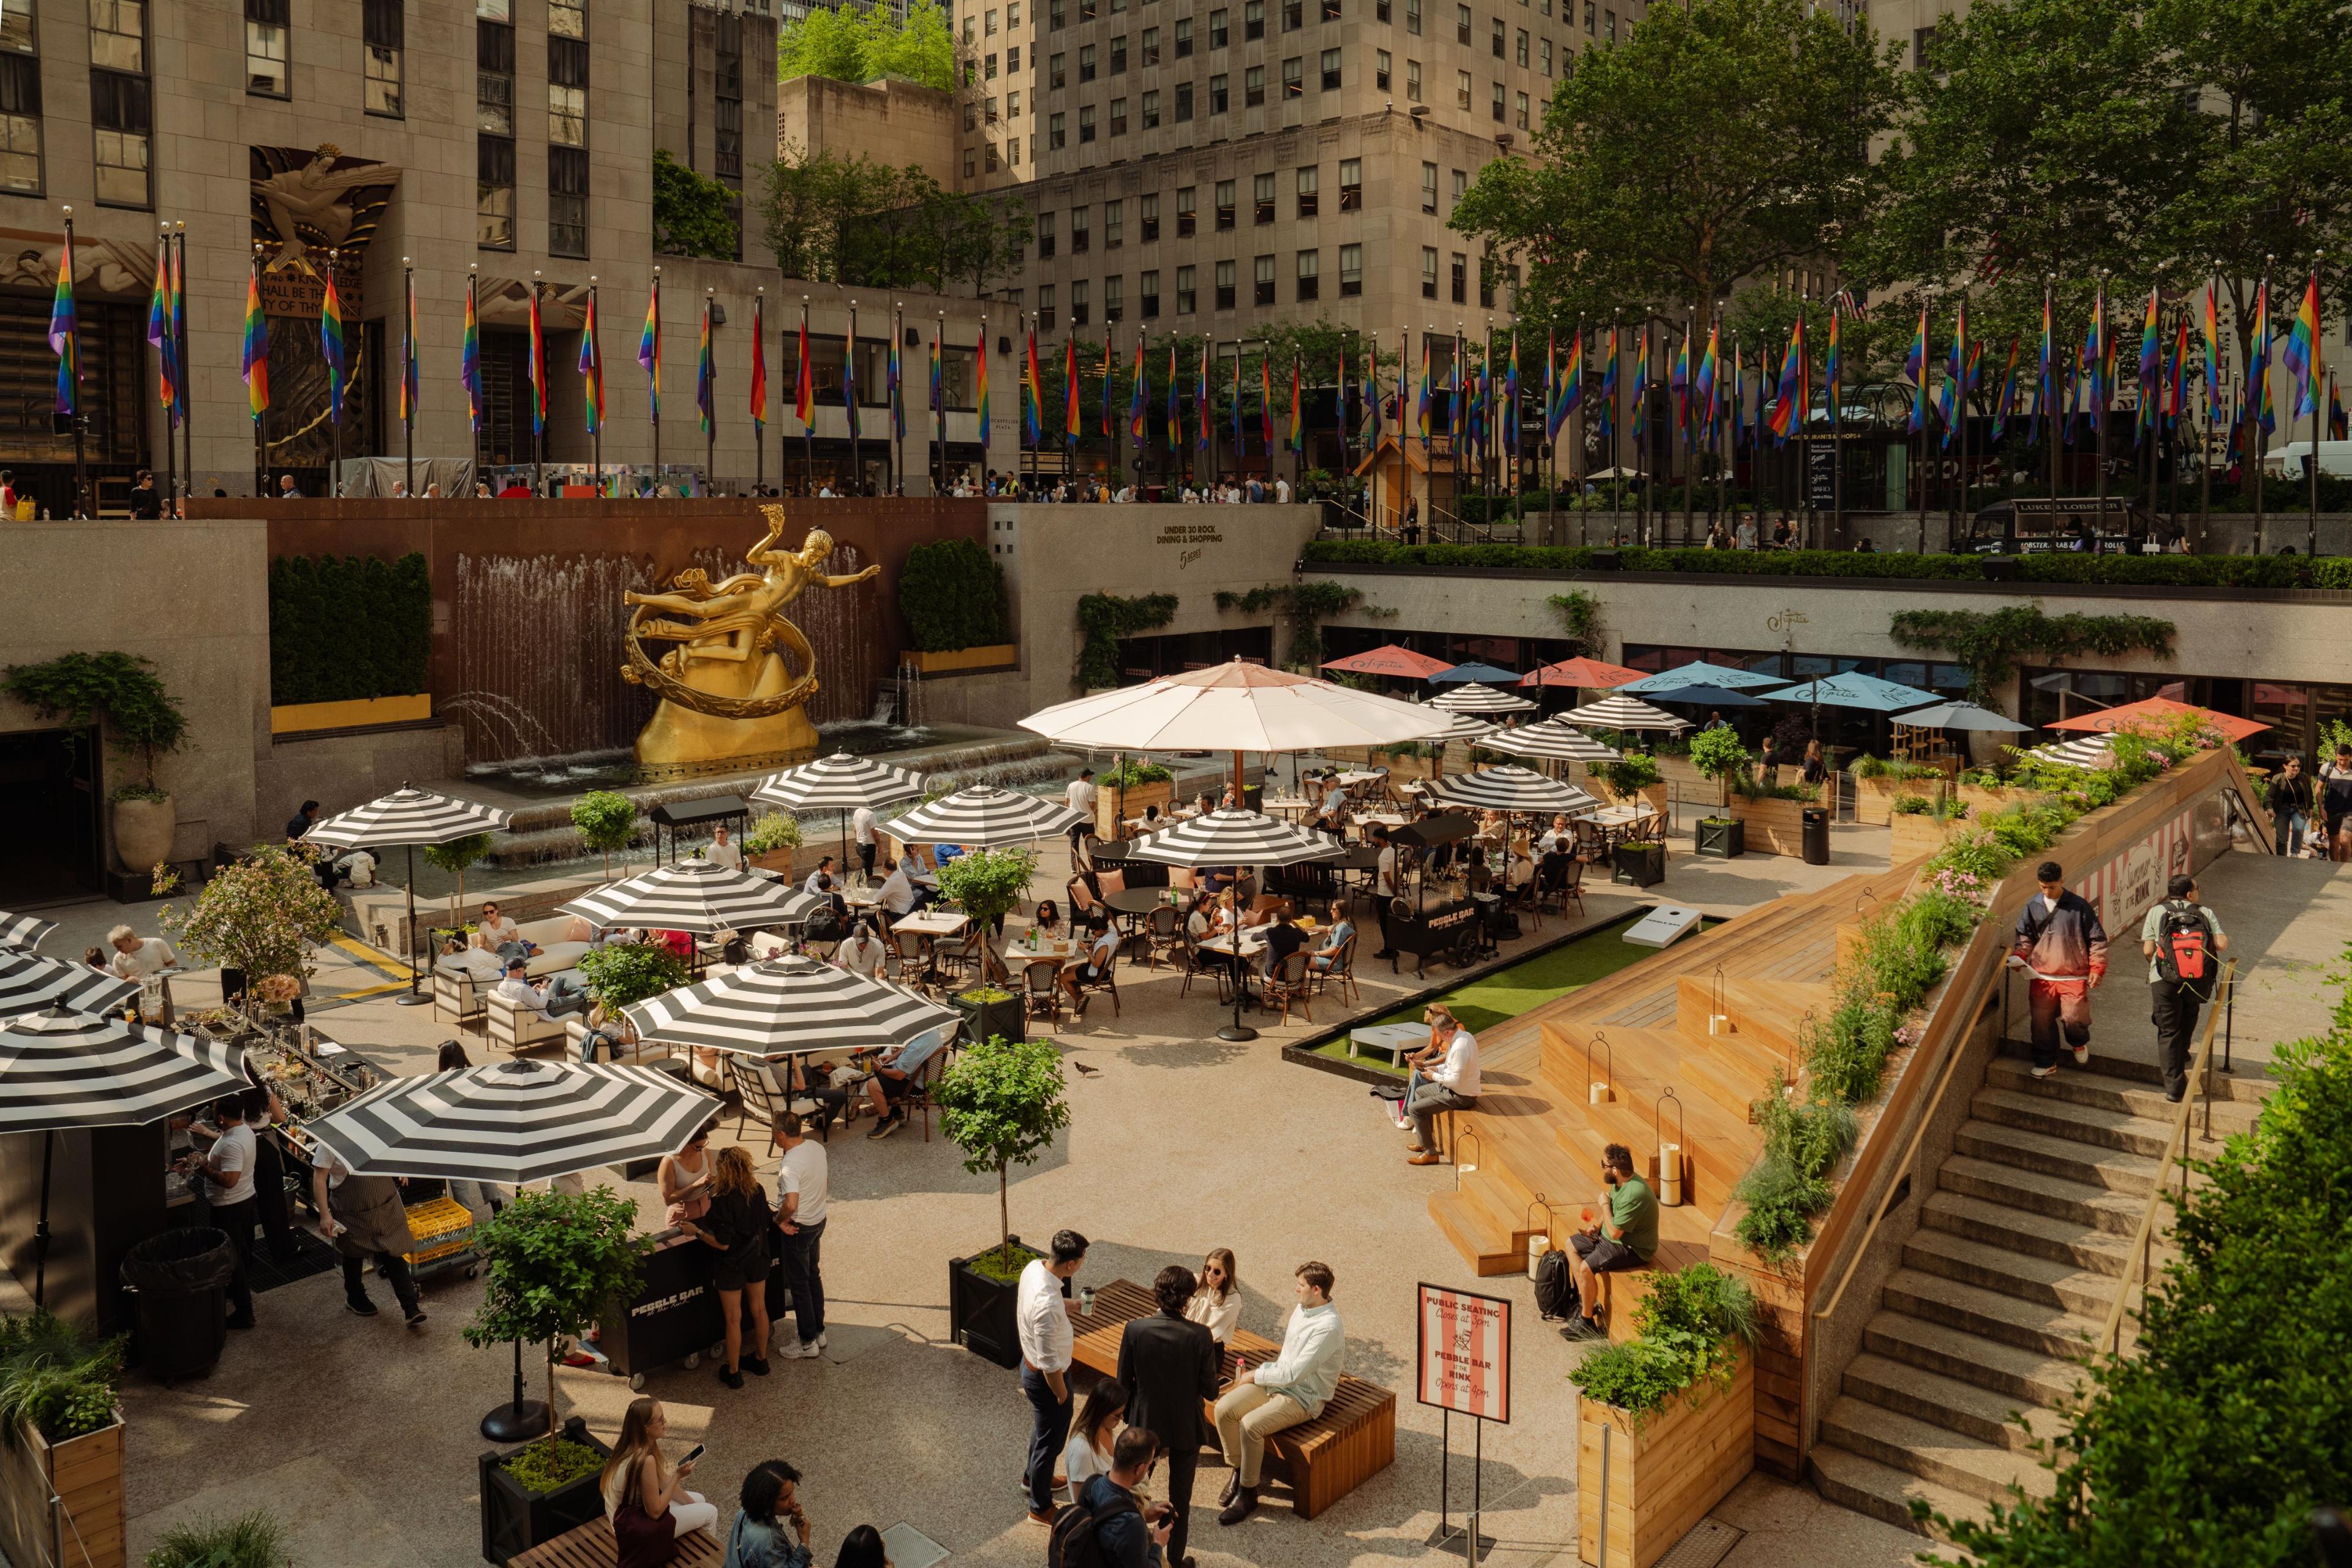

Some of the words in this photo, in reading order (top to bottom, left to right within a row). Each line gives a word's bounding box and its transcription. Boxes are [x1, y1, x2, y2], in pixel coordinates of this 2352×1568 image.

[263, 284, 289, 297] HALL
[293, 287, 305, 298] BE
[279, 300, 295, 311] OF
[299, 301, 321, 314] THY
[1157, 535, 1181, 544] DINING
[1189, 535, 1223, 543] SHOPPING
[1164, 526, 1186, 534] UNDER
[1188, 526, 1196, 534] 30
[1180, 551, 1186, 570] 5
[1187, 548, 1201, 562] ACRES
[1767, 611, 1809, 632] Jupiter
[1350, 657, 1405, 671] Jupiter
[1640, 676, 1697, 690] Jupiter
[1795, 686, 1860, 701] Jupiter
[2126, 858, 2150, 890] Summer
[2135, 878, 2150, 907] RINK
[1428, 912, 1458, 929] PEBBLE
[1459, 907, 1474, 919] BAR
[631, 1295, 677, 1317] PEBBLE
[679, 1286, 704, 1300] BAR
[1427, 1297, 1458, 1310] PUBLIC
[1461, 1303, 1500, 1318] SEATING
[1436, 1308, 1458, 1321] Closes
[1461, 1316, 1470, 1324] at
[1471, 1314, 1490, 1329] 3pm
[1434, 1351, 1469, 1365] PEBBLE
[1472, 1359, 1491, 1370] BAR
[1449, 1370, 1471, 1382] RINK
[1436, 1377, 1458, 1391] Opens
[1471, 1386, 1490, 1398] 4pm
